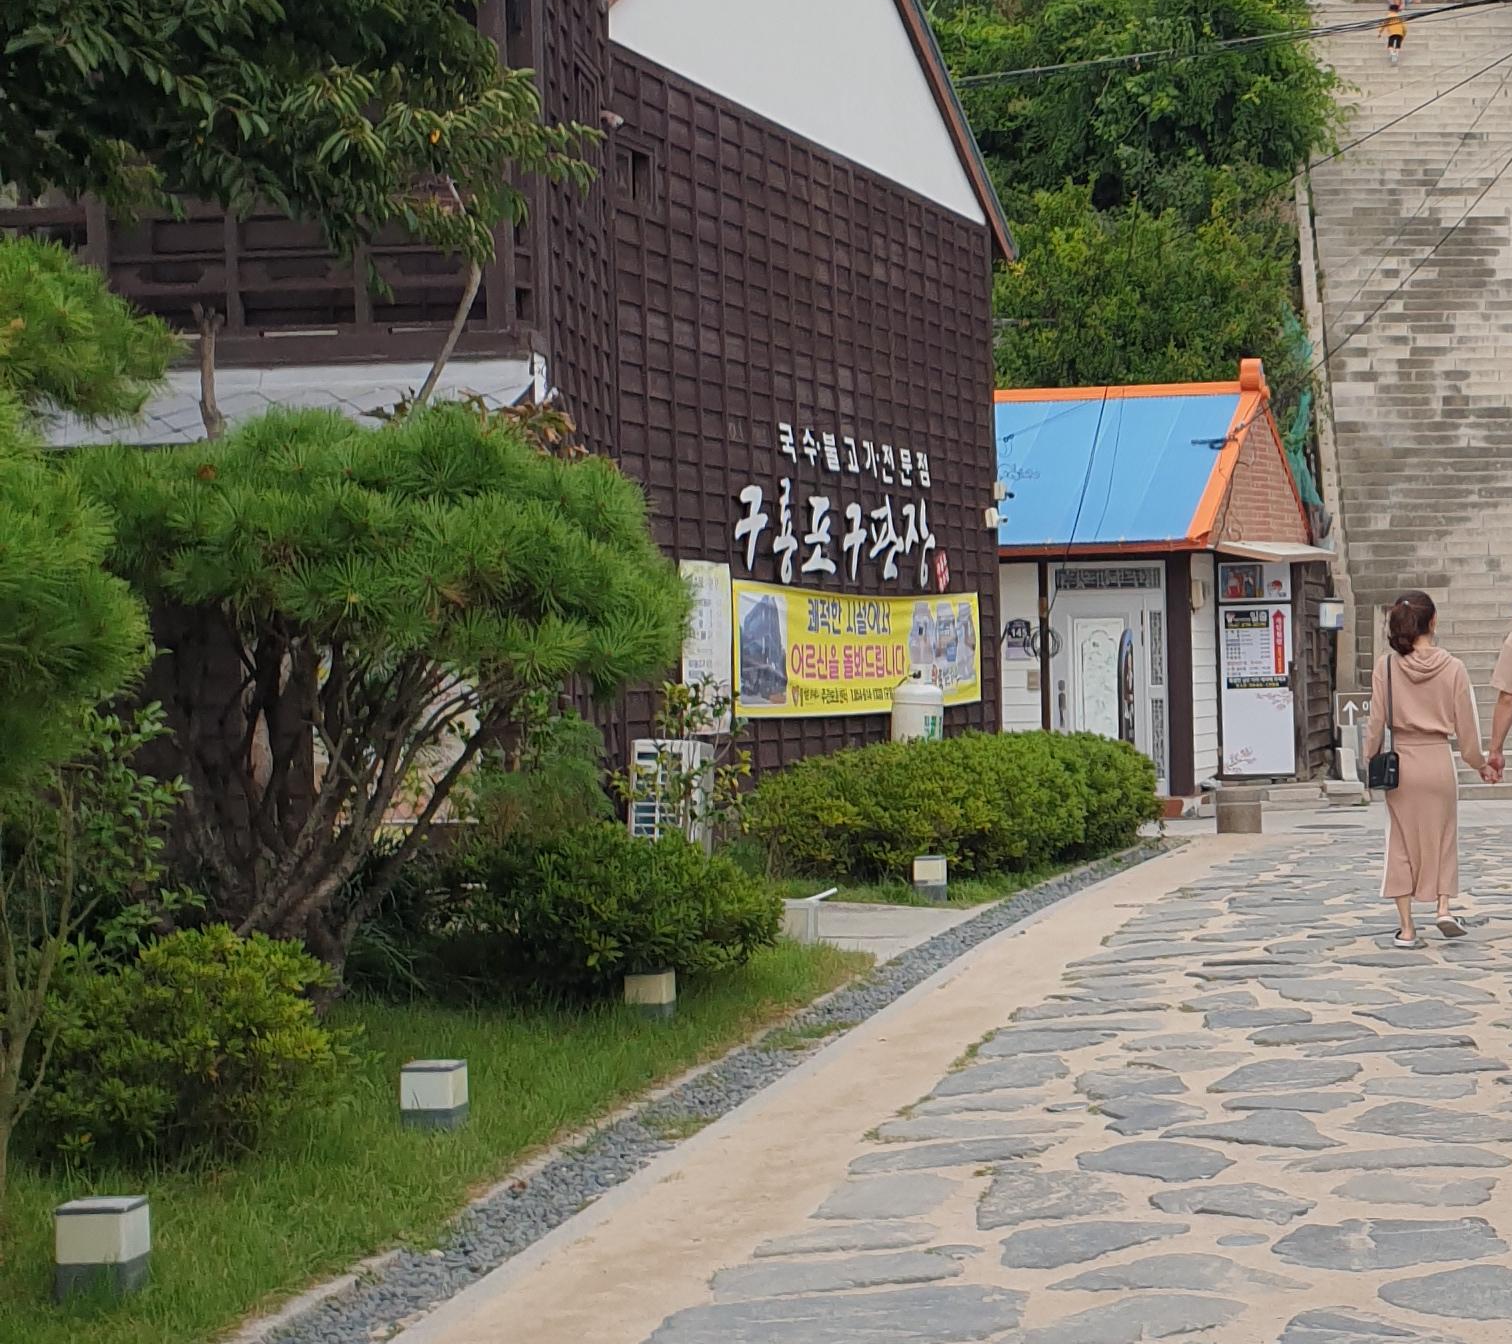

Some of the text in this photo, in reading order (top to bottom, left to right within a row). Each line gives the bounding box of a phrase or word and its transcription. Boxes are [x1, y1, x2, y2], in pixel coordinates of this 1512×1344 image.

[807, 598, 891, 635] 쾌적한 시설에서
[790, 643, 840, 681] 어르신을
[843, 643, 906, 681] 돌봐드립니다
